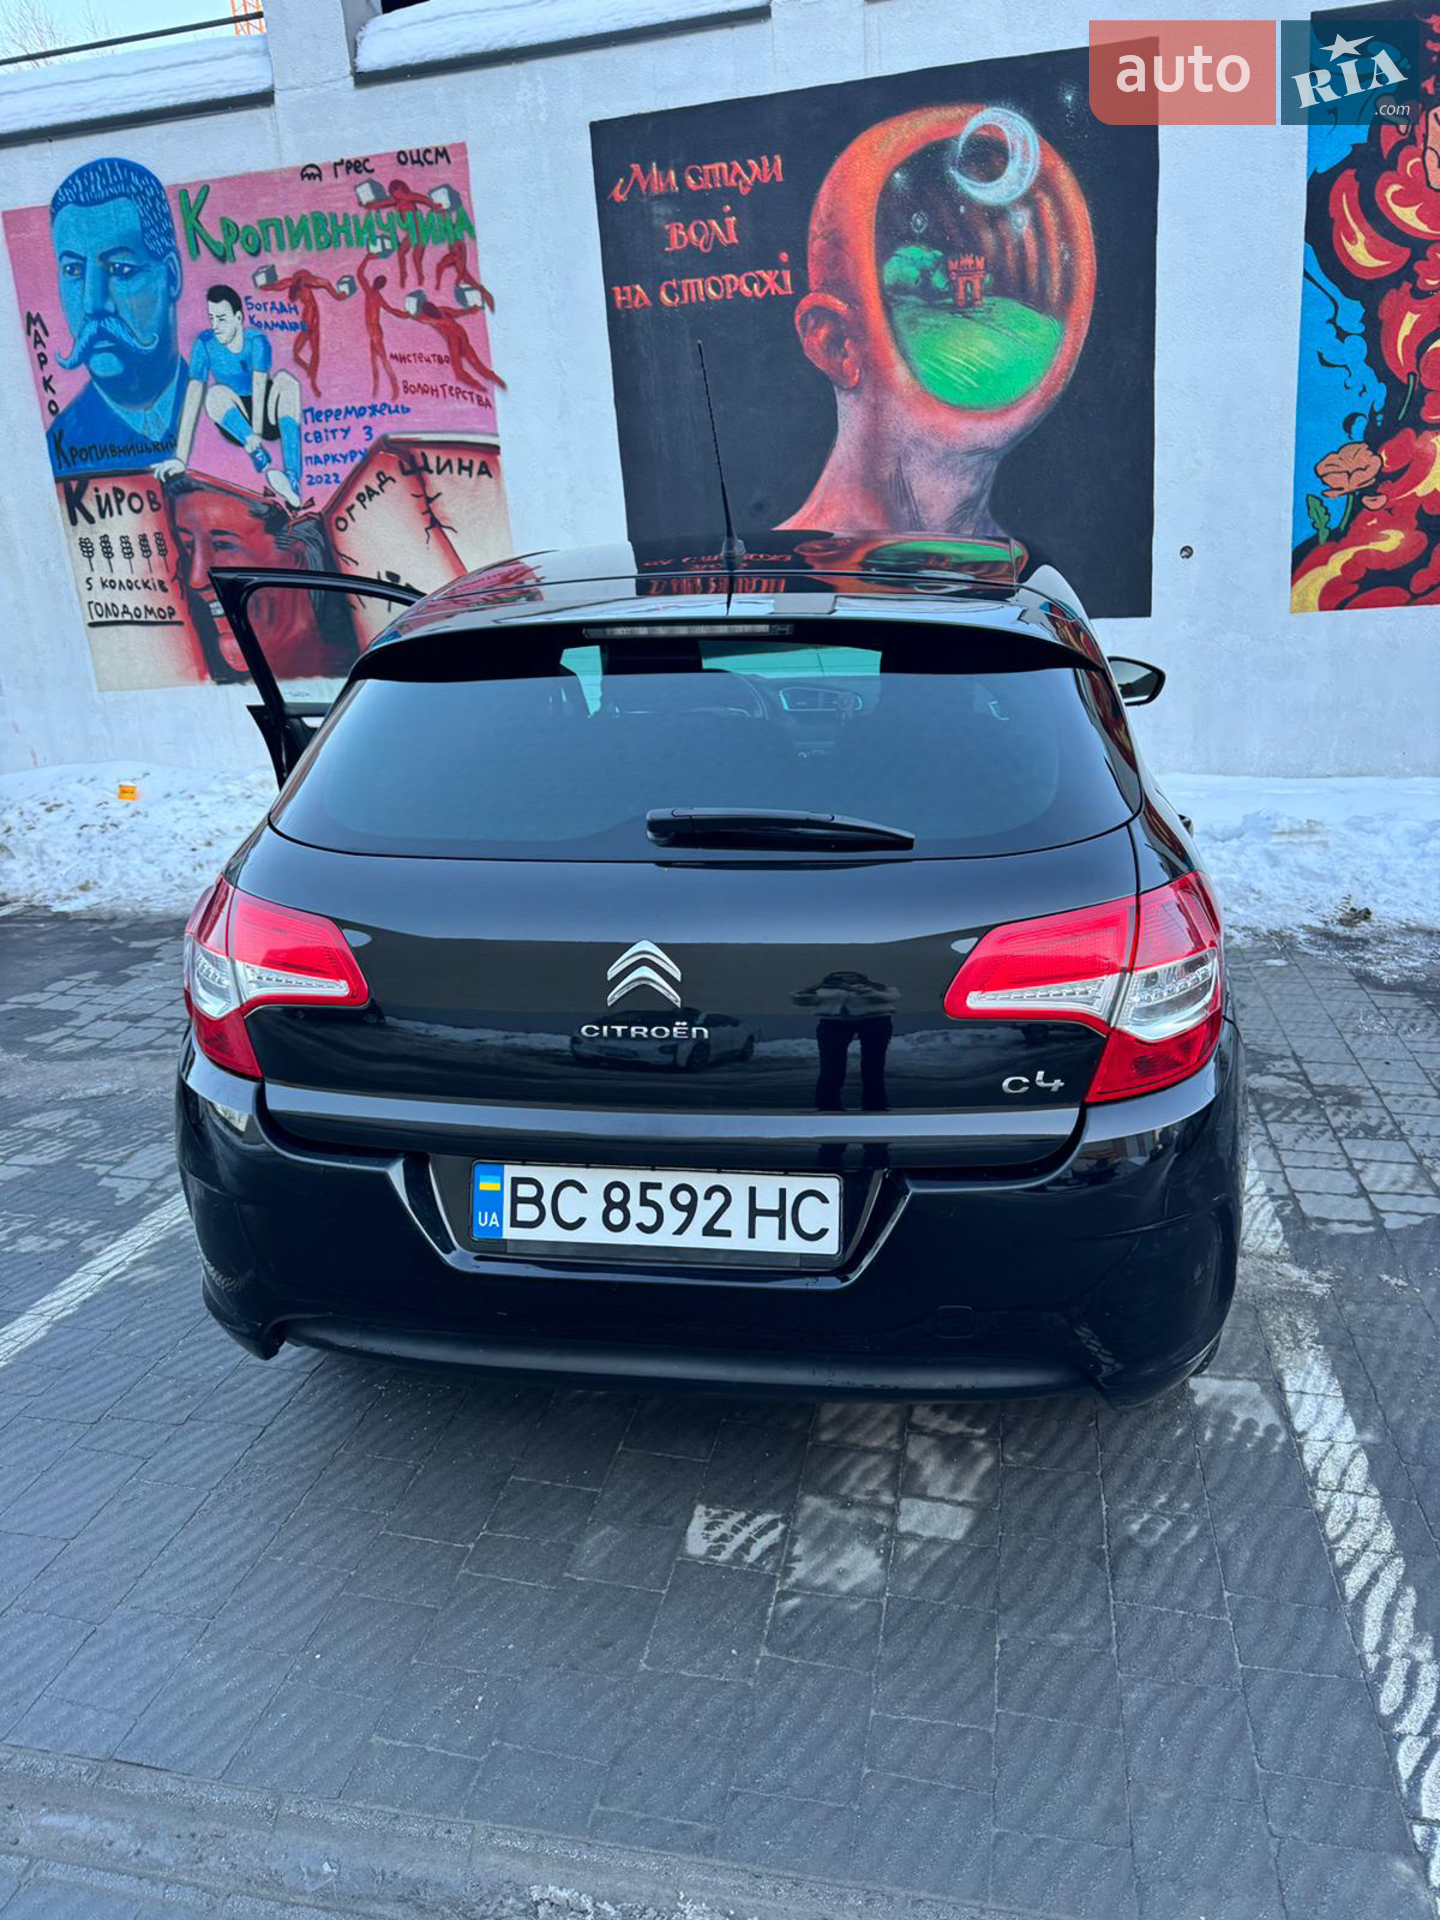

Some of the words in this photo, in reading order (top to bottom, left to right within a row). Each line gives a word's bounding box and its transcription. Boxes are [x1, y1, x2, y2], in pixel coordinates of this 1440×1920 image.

[397, 147, 452, 166] ОЦСМ
[305, 472, 341, 486] 2022
[1002, 1070, 1065, 1094] C4
[510, 1176, 588, 1231] BC
[602, 1181, 732, 1238] 8592
[748, 1186, 830, 1242] HC
[478, 1211, 500, 1228] UA
